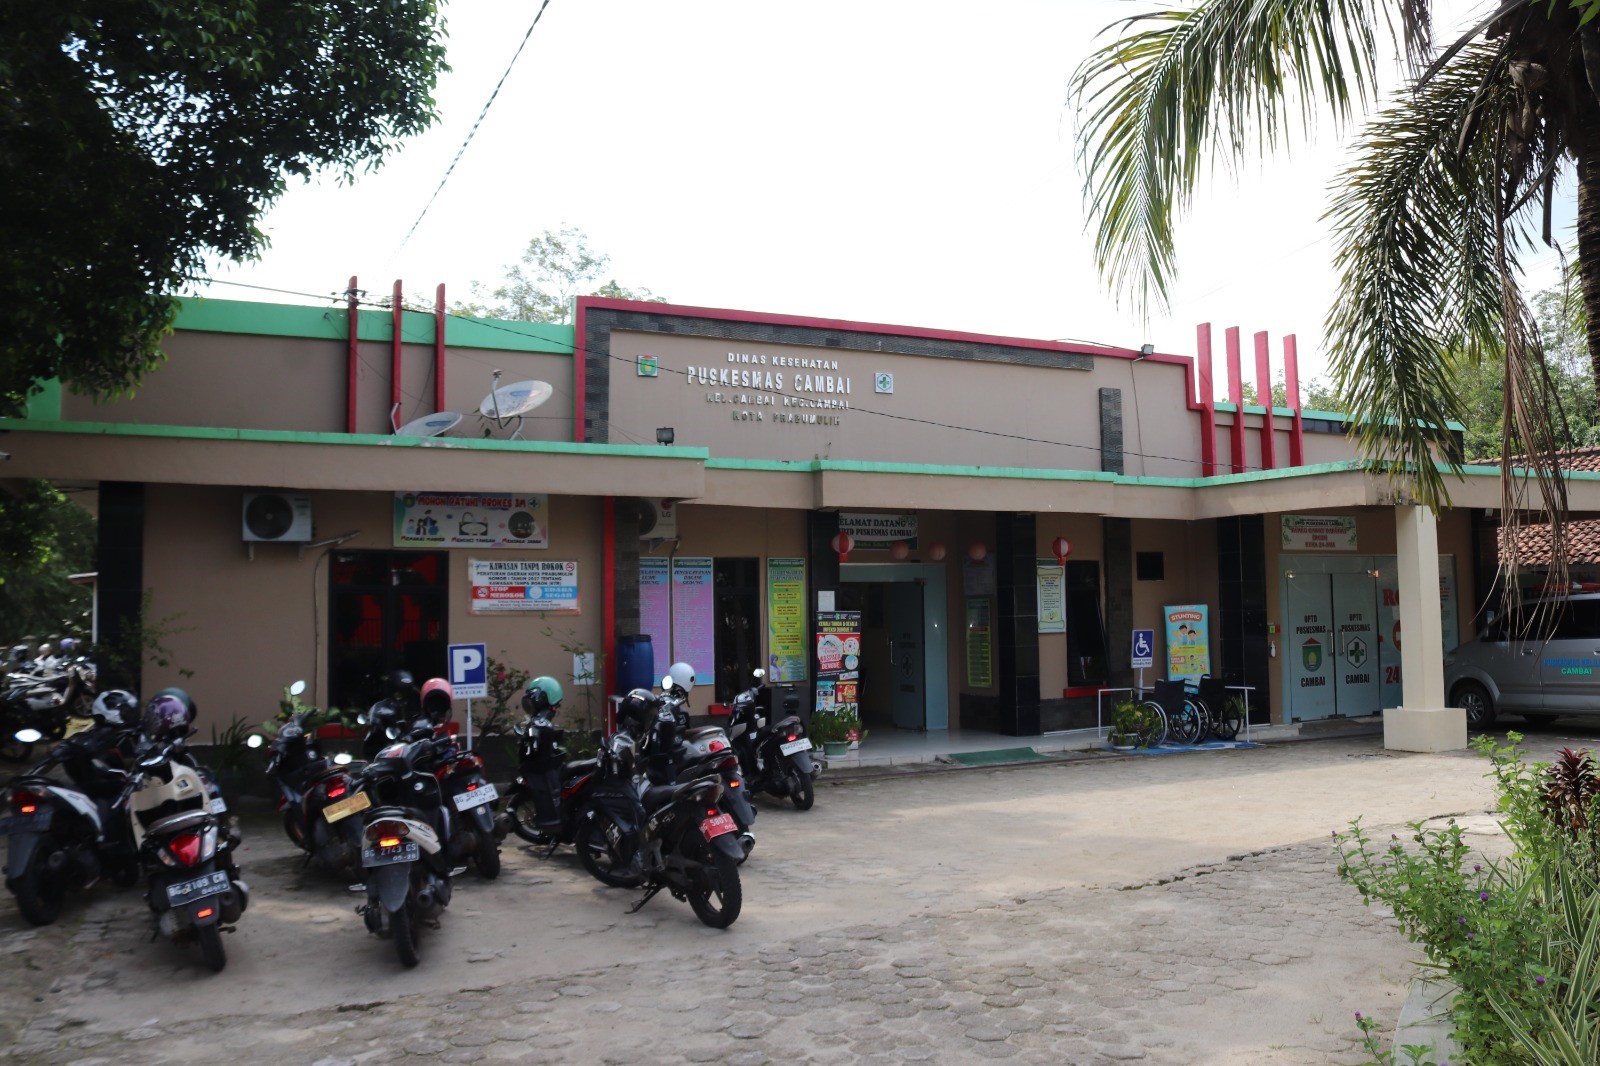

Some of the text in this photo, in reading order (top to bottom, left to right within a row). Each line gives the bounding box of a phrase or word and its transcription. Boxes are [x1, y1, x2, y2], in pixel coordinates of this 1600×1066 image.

[727, 352, 838, 370] DINAS KESEHATAN
[687, 366, 850, 394] PUSKESMAS CAMBAI
[732, 410, 840, 426] KOTA PRABUMULIH
[417, 496, 446, 506] MOHON
[448, 496, 478, 507] PATUHI
[481, 497, 512, 508] PROKES
[839, 519, 906, 528] ELAMAT DATANG
[856, 528, 889, 537] PUSKESMAS
[890, 529, 912, 537] CAMBAI
[489, 562, 564, 571] KAWASAN TANPA ROKOK
[1170, 613, 1200, 621] STUNTING
[1296, 625, 1326, 635] PUSKESMAS
[1341, 623, 1371, 633] PUSKESMAS
[452, 648, 482, 683] P
[1346, 673, 1370, 684] CAMBAI
[1385, 666, 1400, 684] 24
[1301, 676, 1326, 688] CAMBAI
[455, 796, 464, 804] BG
[364, 843, 416, 858] BG 2743 CS
[168, 885, 182, 897] BG
